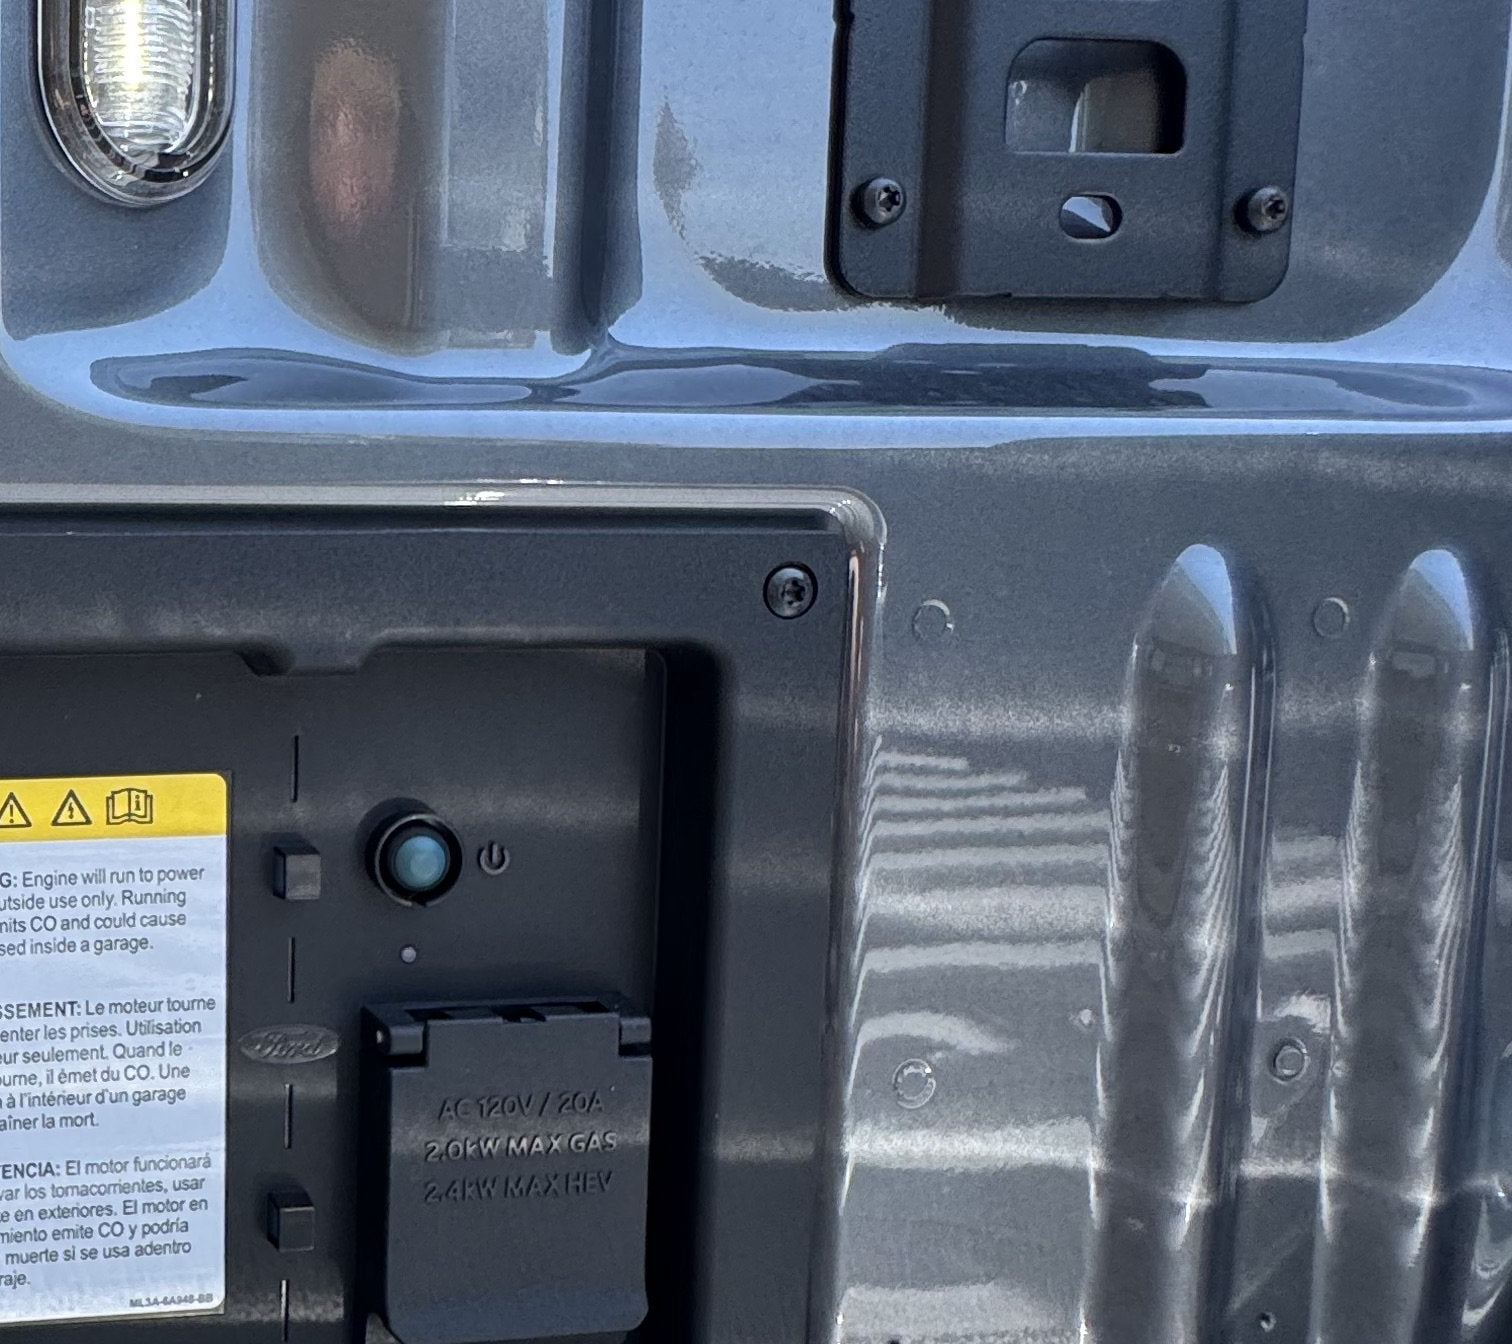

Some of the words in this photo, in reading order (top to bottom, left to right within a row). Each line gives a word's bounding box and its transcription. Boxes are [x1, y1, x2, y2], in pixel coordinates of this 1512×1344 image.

[21, 868, 78, 891] Engine
[80, 867, 106, 885] will
[109, 870, 135, 884] run
[138, 867, 154, 883] to
[156, 868, 206, 886] power
[48, 895, 78, 909] use
[80, 889, 118, 912] only.
[121, 887, 186, 910] Running
[29, 914, 57, 932] CO
[60, 913, 90, 931] and
[93, 911, 136, 929] could
[139, 913, 186, 928] cause
[29, 937, 77, 955] inside
[79, 940, 90, 954] a
[93, 938, 154, 957] garage.
[85, 999, 105, 1016] Le
[108, 997, 164, 1015] moteur
[166, 995, 216, 1013] tourne
[43, 1022, 67, 1040] les
[70, 1020, 122, 1043] prises.
[125, 1016, 202, 1037] Utilisation
[21, 1043, 109, 1064] seulement.
[112, 1040, 165, 1060] Quand
[168, 1039, 183, 1057] le
[45, 1067, 54, 1085] il
[57, 1066, 98, 1084] émet
[100, 1065, 121, 1082] du
[123, 1064, 155, 1081] CO.
[158, 1062, 191, 1080] Une
[6, 1091, 16, 1108] à
[95, 1086, 128, 1105] d'un
[132, 1088, 186, 1107] garage
[438, 1097, 472, 1121] AC
[476, 1094, 532, 1118] 120V
[557, 1090, 604, 1114] 20A
[41, 1112, 56, 1129] la
[58, 1111, 99, 1128] mort.
[505, 1133, 563, 1157] MAX
[568, 1130, 618, 1153] GAS
[65, 1159, 81, 1176] El
[84, 1157, 130, 1175] motor
[132, 1152, 212, 1173] funcionará
[24, 1181, 47, 1199] los
[50, 1175, 168, 1200] tomacorrientes,
[172, 1177, 205, 1192] usar
[503, 1172, 560, 1198] MAX
[564, 1170, 613, 1195] HEV
[13, 1208, 34, 1222] en
[37, 1199, 118, 1220] exteriores.
[122, 1198, 138, 1216] El
[142, 1196, 186, 1214] motor
[188, 1198, 208, 1212] en
[51, 1222, 94, 1241] emite
[97, 1221, 125, 1239] CO
[128, 1224, 138, 1241] y
[141, 1217, 189, 1240] podría
[5, 1246, 59, 1265] muerte
[62, 1244, 76, 1261] si
[79, 1246, 99, 1260] se
[102, 1245, 130, 1259] usa
[134, 1237, 192, 1257] adentro
